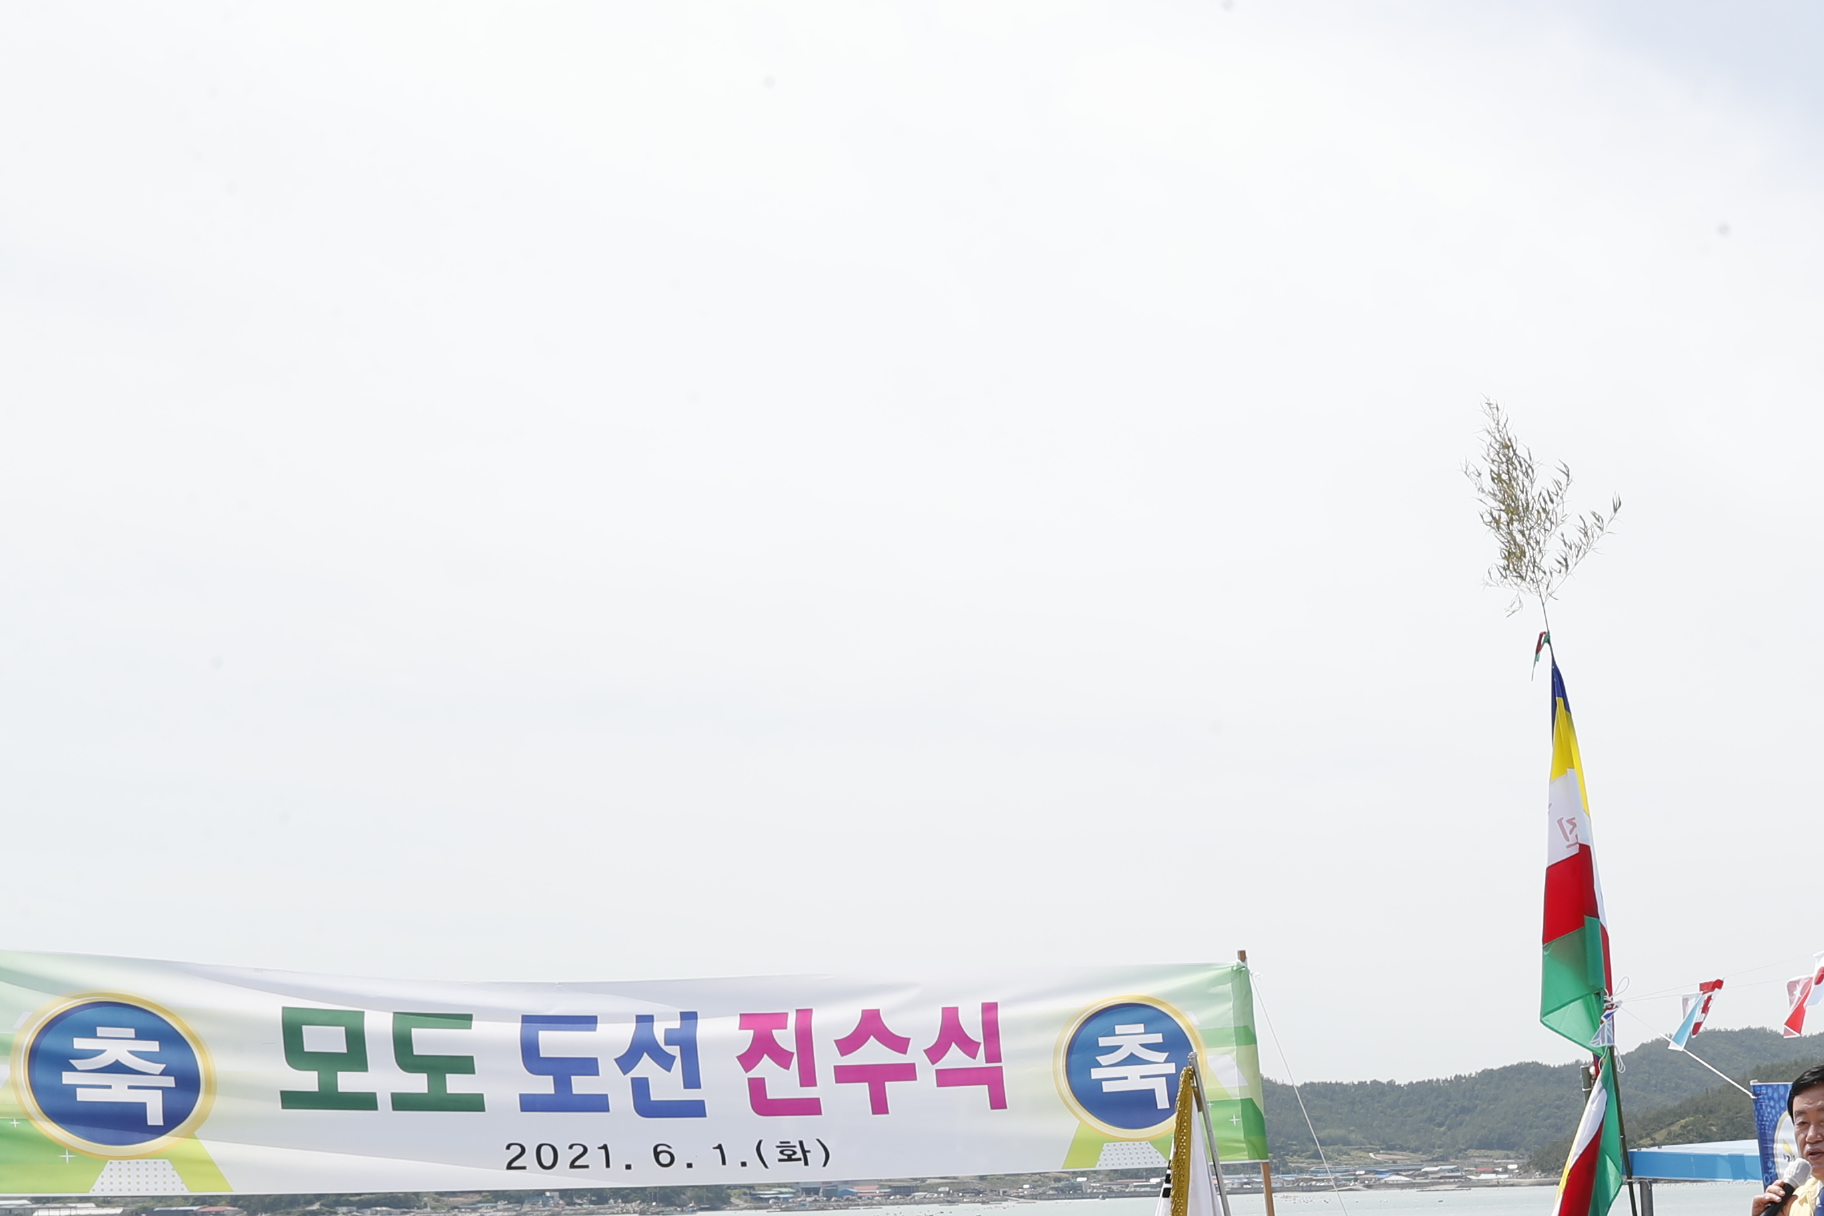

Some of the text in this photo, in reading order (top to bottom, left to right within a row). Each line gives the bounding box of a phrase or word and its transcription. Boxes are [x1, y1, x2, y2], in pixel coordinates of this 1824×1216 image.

[61, 1026, 177, 1126] 축
[279, 1001, 1008, 1119] 모도 도선 진수식
[1090, 1023, 1177, 1110] 축
